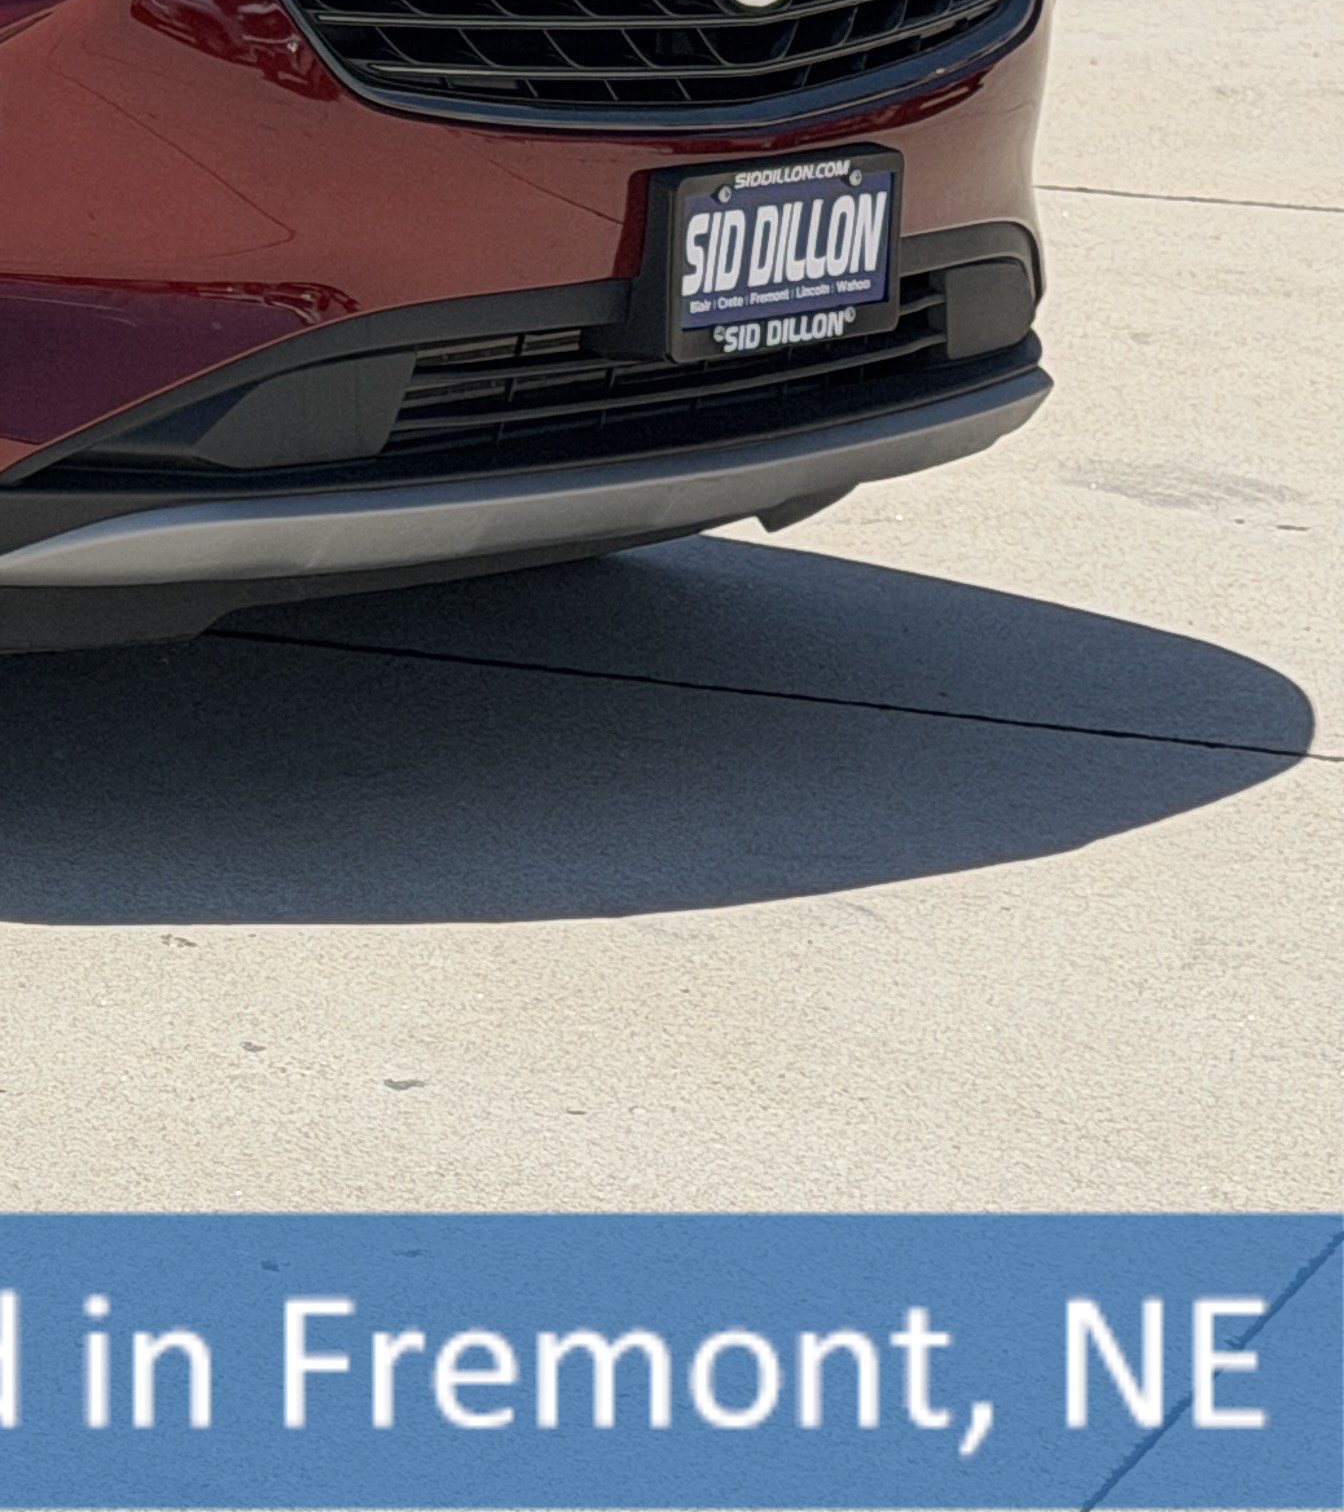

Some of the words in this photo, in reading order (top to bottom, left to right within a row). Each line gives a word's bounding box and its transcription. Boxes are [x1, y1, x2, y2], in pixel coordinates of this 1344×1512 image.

[734, 159, 851, 189] SIDDILLON.COM
[681, 210, 746, 297] SID
[747, 191, 888, 288] DILLON
[723, 322, 761, 353] SID
[766, 310, 845, 346] DILLON
